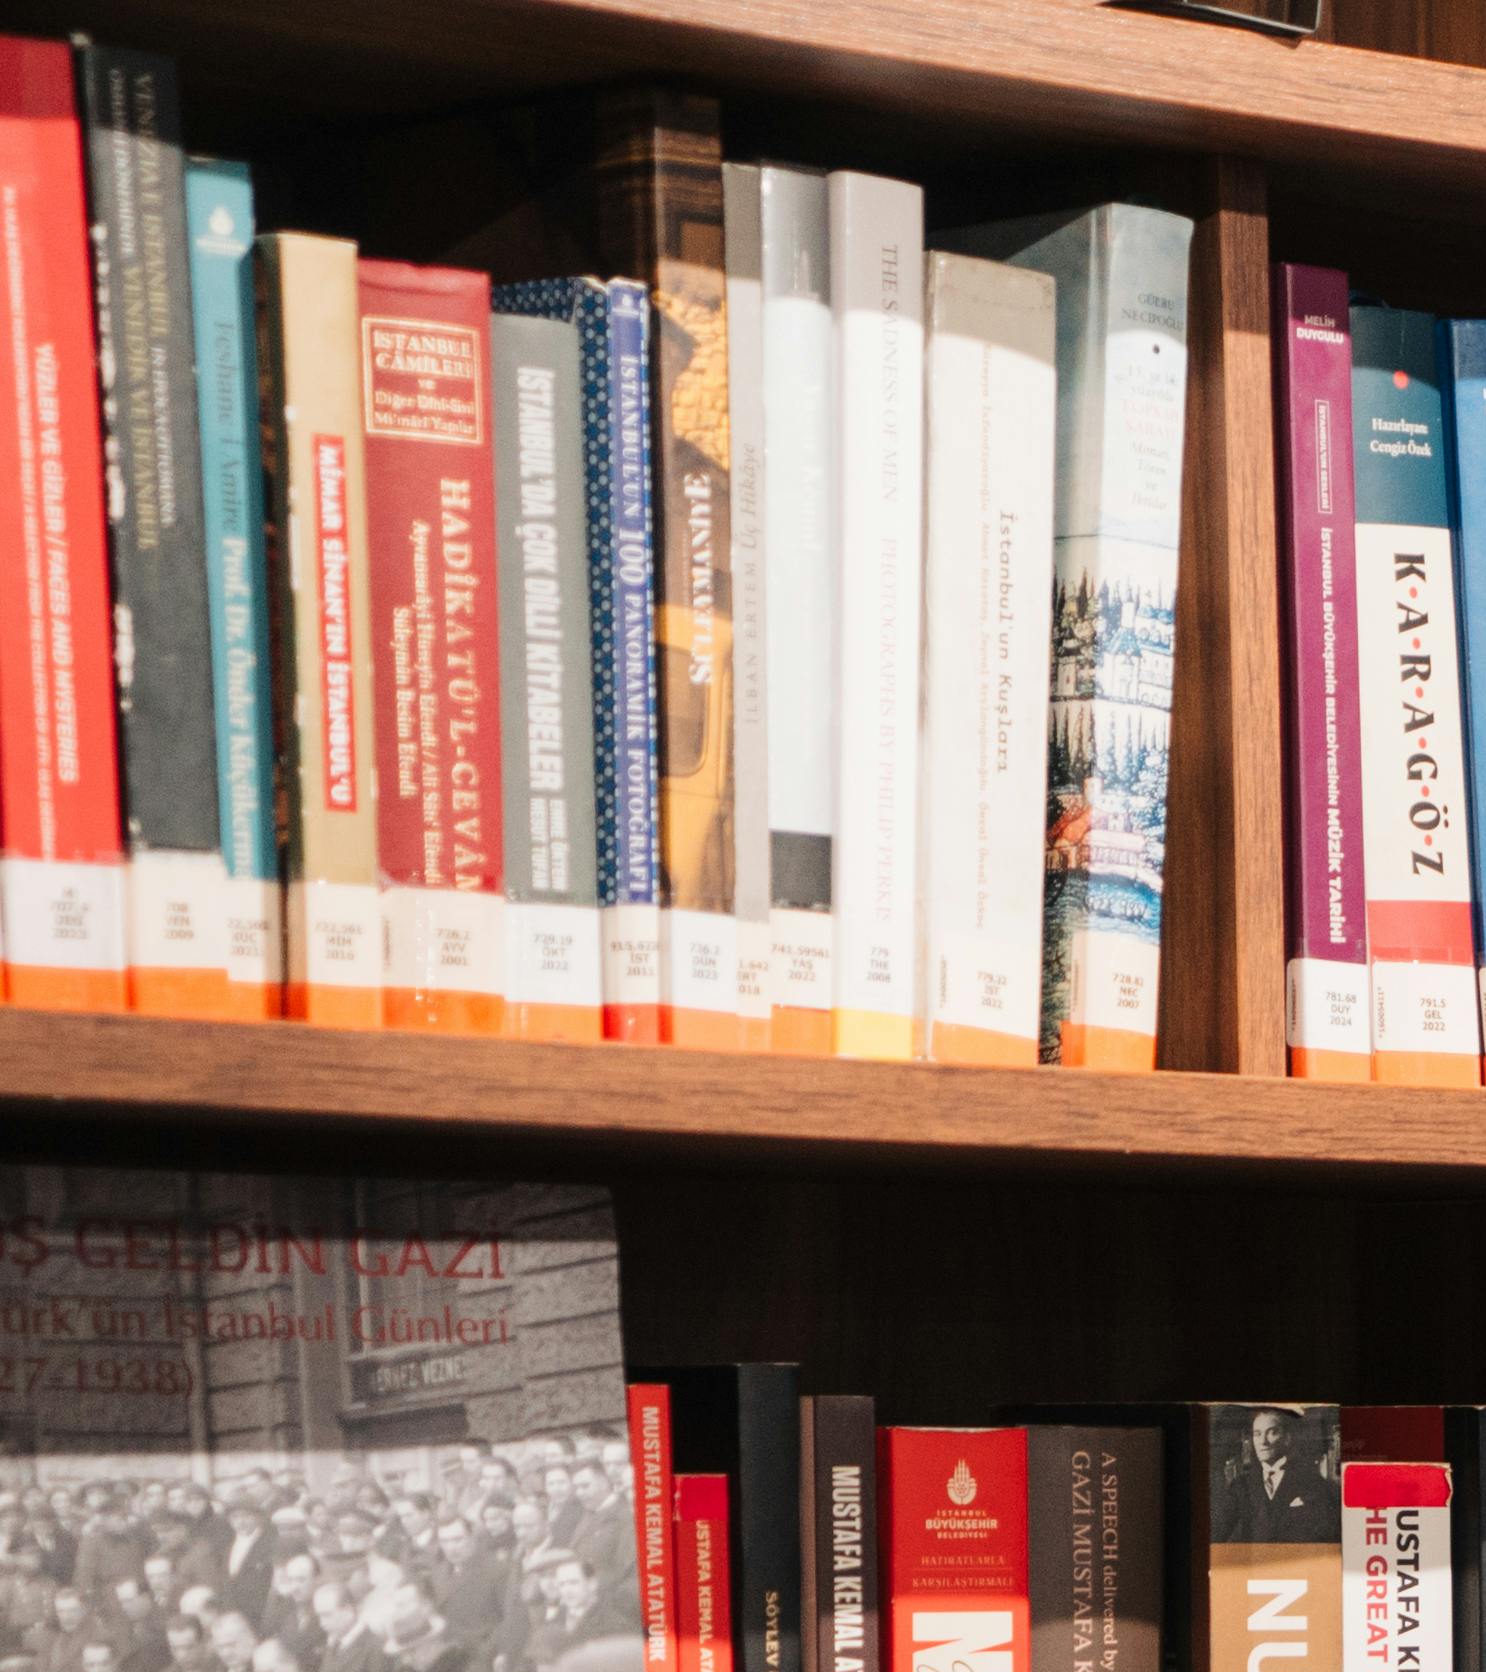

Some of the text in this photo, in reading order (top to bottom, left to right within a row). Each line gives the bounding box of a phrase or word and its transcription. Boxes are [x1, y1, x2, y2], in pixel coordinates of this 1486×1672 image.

[319, 445, 342, 528] MİMAR
[34, 344, 77, 782] YÜZLER VE GİZLER FACES AND MYSTERIES
[516, 523, 556, 573] ÇOK
[619, 528, 647, 585] 100
[875, 245, 901, 921] THE SADNESS OF MEN PHOTOGRAPHS BY PHILIP PERKIS
[1321, 527, 1335, 597] İSTANBUL
[525, 579, 560, 638] DİLLİ
[624, 594, 647, 739] PANORAMİK
[526, 643, 563, 790] KİTABELER
[994, 674, 1015, 774] Kuşları
[628, 748, 651, 892] FOTOĞRAFI
[1327, 809, 1344, 872] MÜZİK
[1330, 878, 1346, 943] TARİHİ
[78, 1218, 505, 1280] GELDİN GAZİ
[162, 1295, 511, 1345] İstanbul Günleri
[833, 1466, 862, 1570] MUSTAFA
[1071, 1451, 1095, 1515] GAZİ
[643, 1406, 668, 1662] MUSTAFA KEMAL ATATÜRK
[1100, 1453, 1118, 1670] A SPEECH delivered by
[1365, 1505, 1388, 1546] HE
[834, 1576, 863, 1651] KEMAL
[1073, 1524, 1093, 1653] MUSTAFA
[1365, 1555, 1389, 1662] GREAT
[1397, 1509, 1420, 1635] USTAFA
[764, 1591, 782, 1665] SÖYLEV
